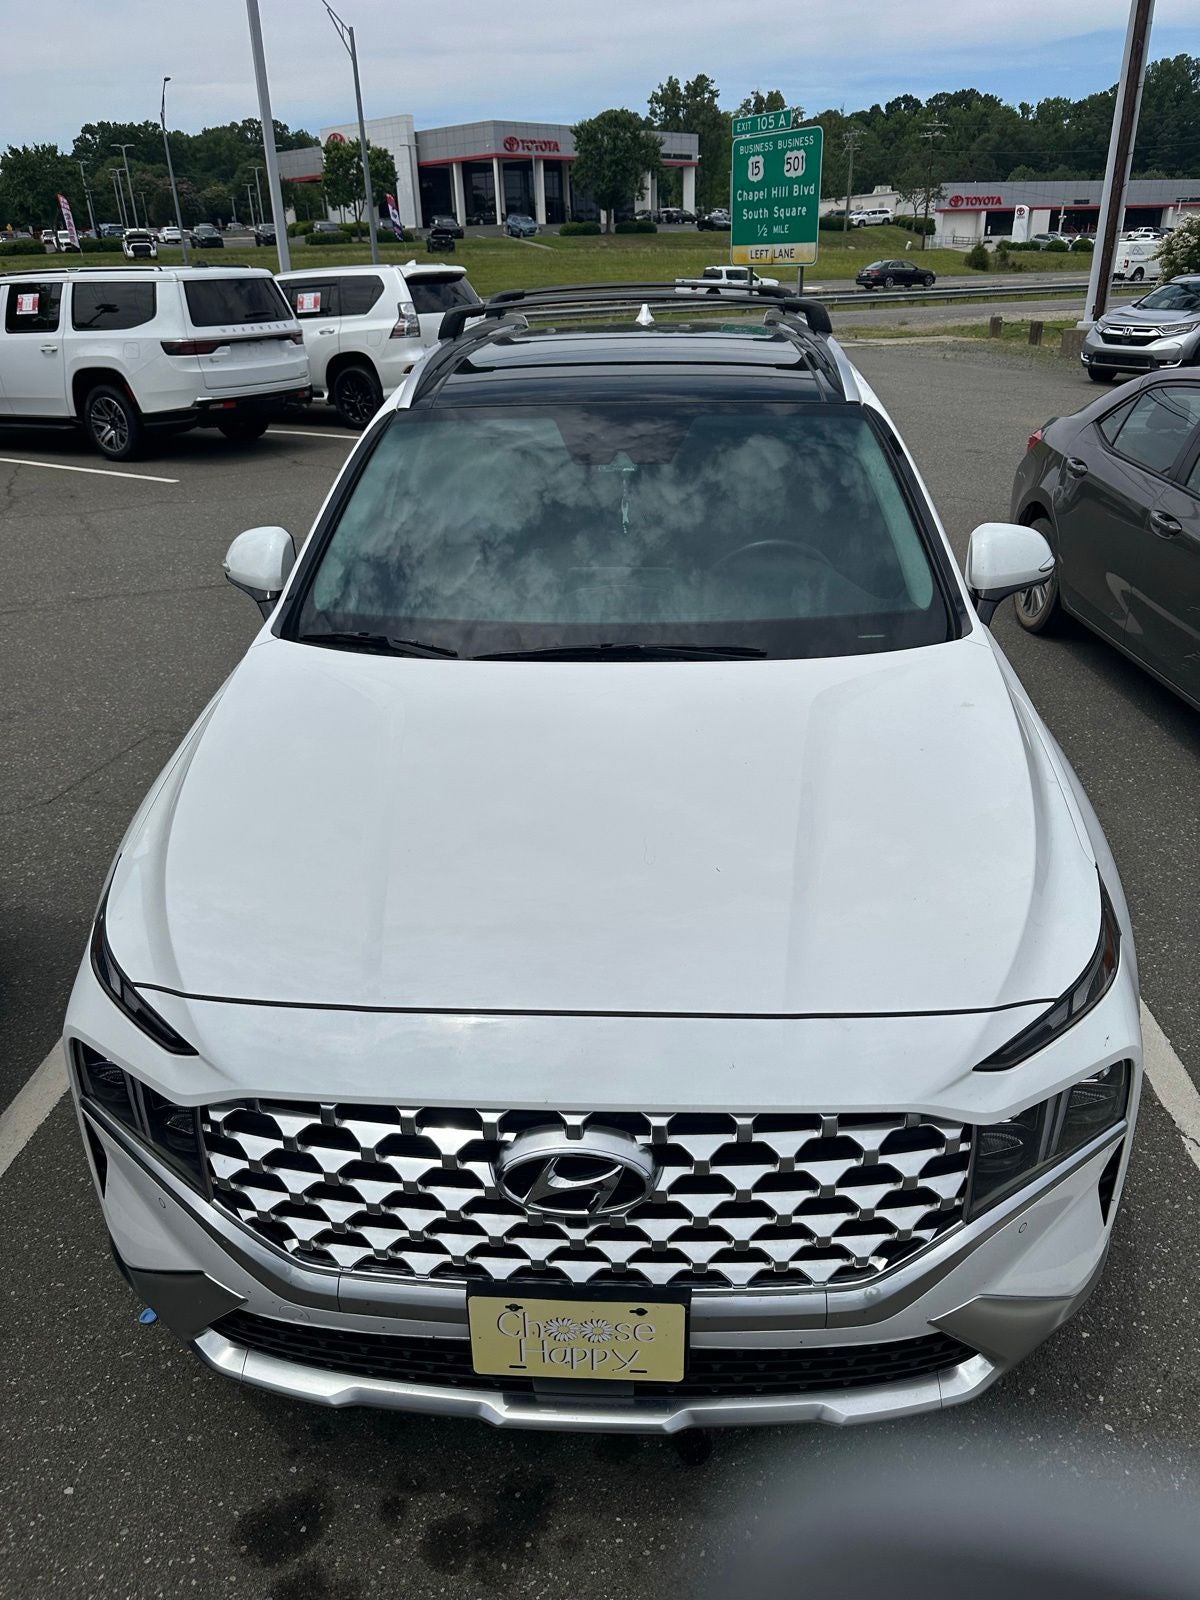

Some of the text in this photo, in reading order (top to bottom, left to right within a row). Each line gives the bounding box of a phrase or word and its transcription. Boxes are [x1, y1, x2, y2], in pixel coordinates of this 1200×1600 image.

[737, 114, 786, 132] EXIT 105 A
[520, 139, 560, 152] TOYOTA
[740, 136, 814, 154] BUSINESS BUSINESS
[751, 156, 804, 176] 15 501
[737, 184, 815, 202] Chapel Hill Blvd
[964, 196, 1002, 206] TOYOTA
[743, 206, 807, 219] South Square
[773, 224, 789, 234] MILE
[750, 248, 795, 260] LEFT LANE
[519, 1338, 641, 1372] Happy
